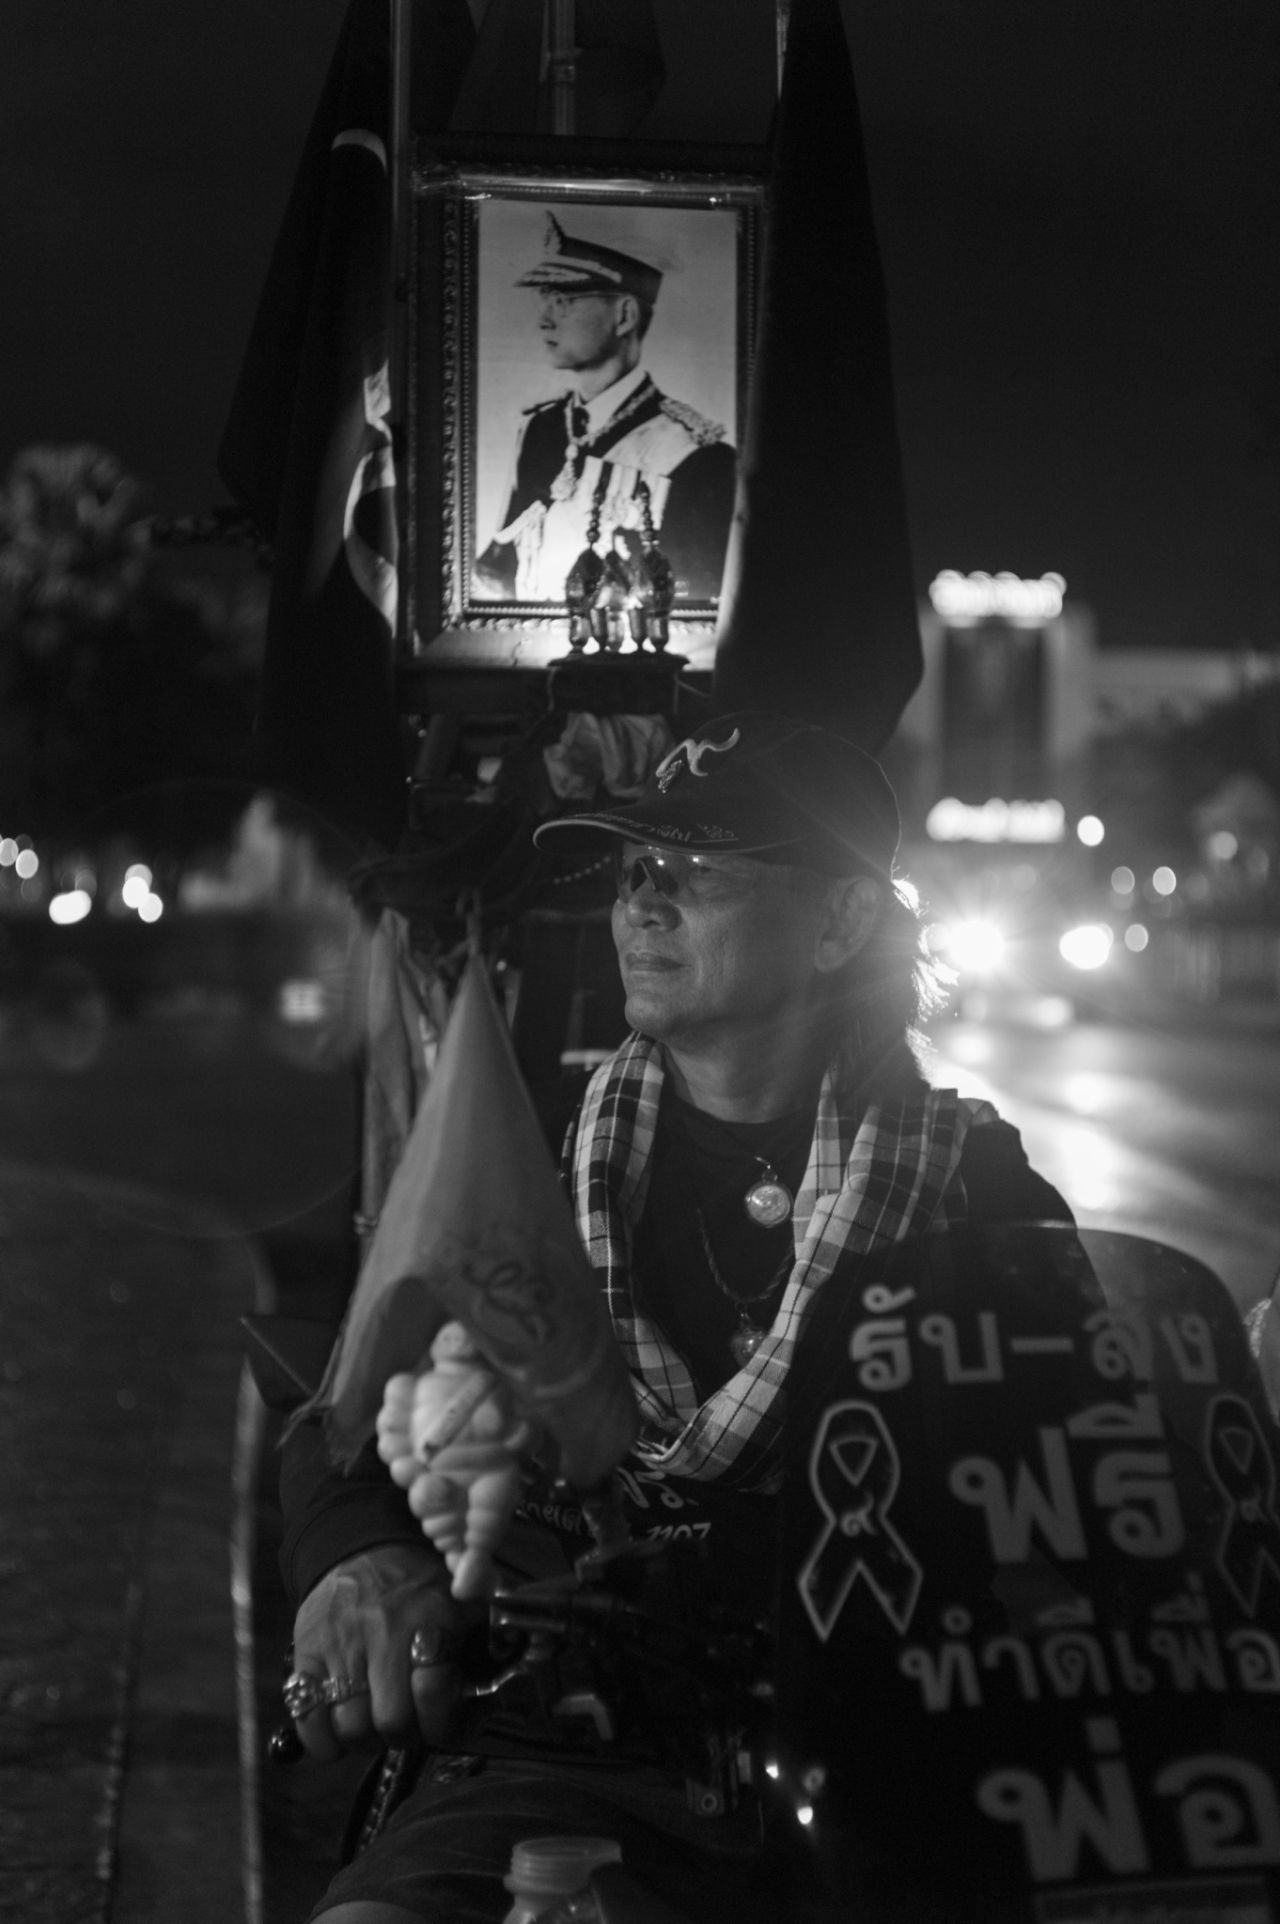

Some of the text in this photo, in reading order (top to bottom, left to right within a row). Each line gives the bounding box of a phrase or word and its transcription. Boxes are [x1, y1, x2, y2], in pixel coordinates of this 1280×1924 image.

[949, 1393, 1186, 1564] ฟรี
[900, 1570, 1280, 1713] ทำดีเพื่อ
[976, 1715, 1280, 1882] พ่อ
